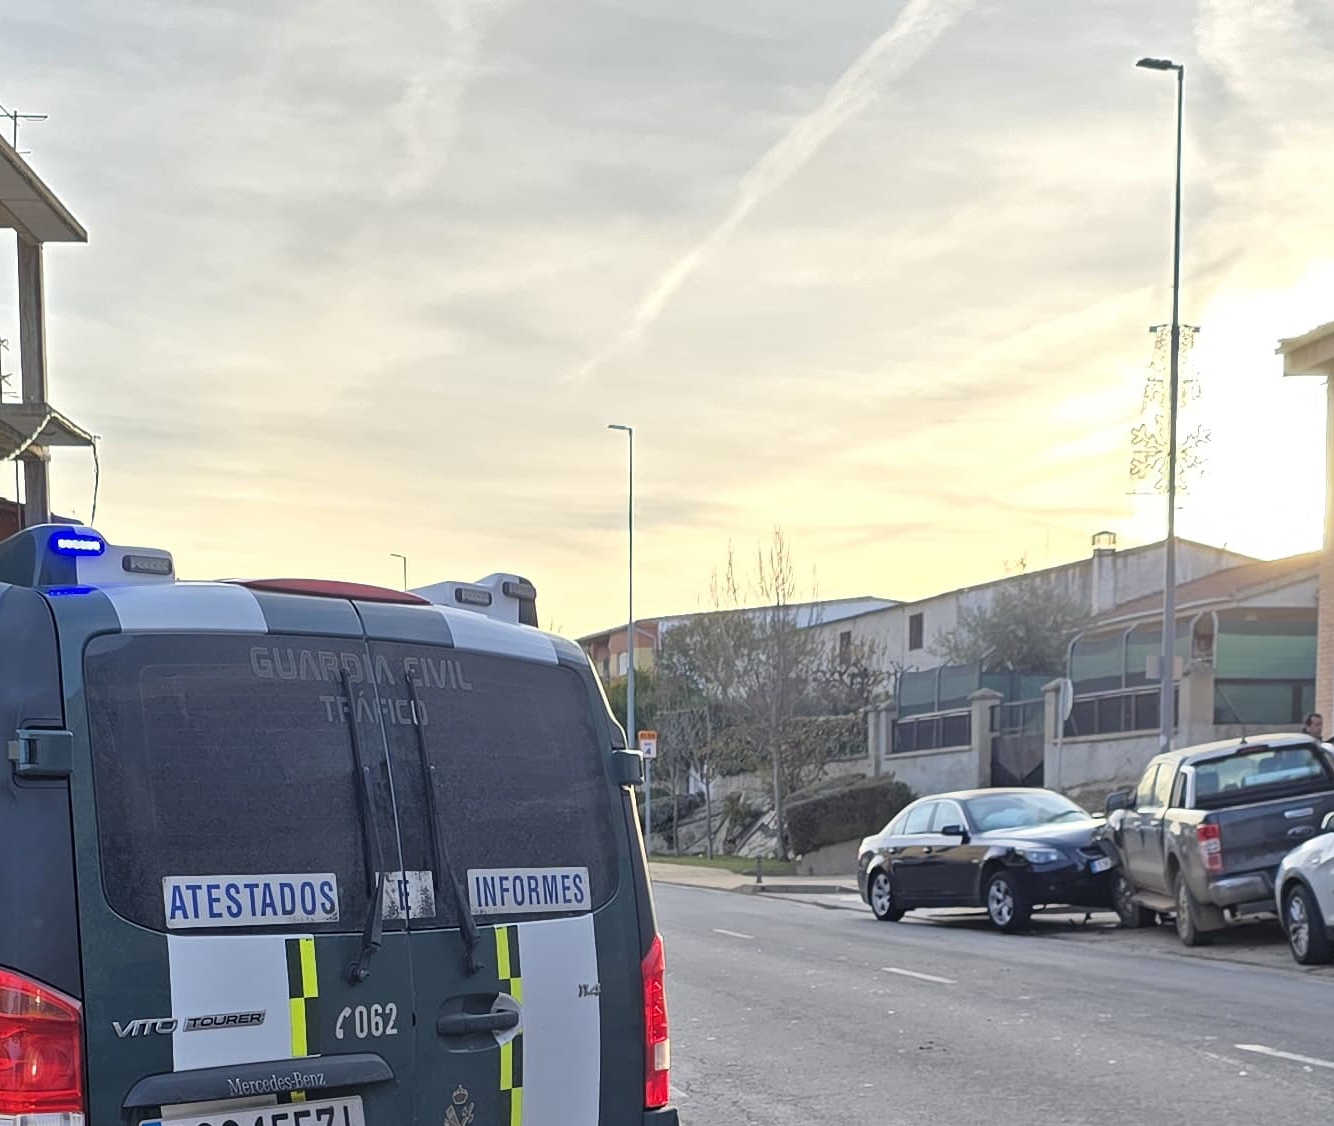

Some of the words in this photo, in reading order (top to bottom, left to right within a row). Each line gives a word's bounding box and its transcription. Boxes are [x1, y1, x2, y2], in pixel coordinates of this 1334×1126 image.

[250, 647, 396, 686] GUARDIA
[404, 657, 474, 690] CIVIL
[169, 880, 337, 920] ATESTADOS
[399, 879, 412, 911] E
[475, 874, 585, 908] INFORMES
[112, 1017, 179, 1038] VITO
[189, 1013, 263, 1029] TOURER
[354, 1002, 398, 1039] 062
[227, 1071, 327, 1096] Mercedes-Benz
